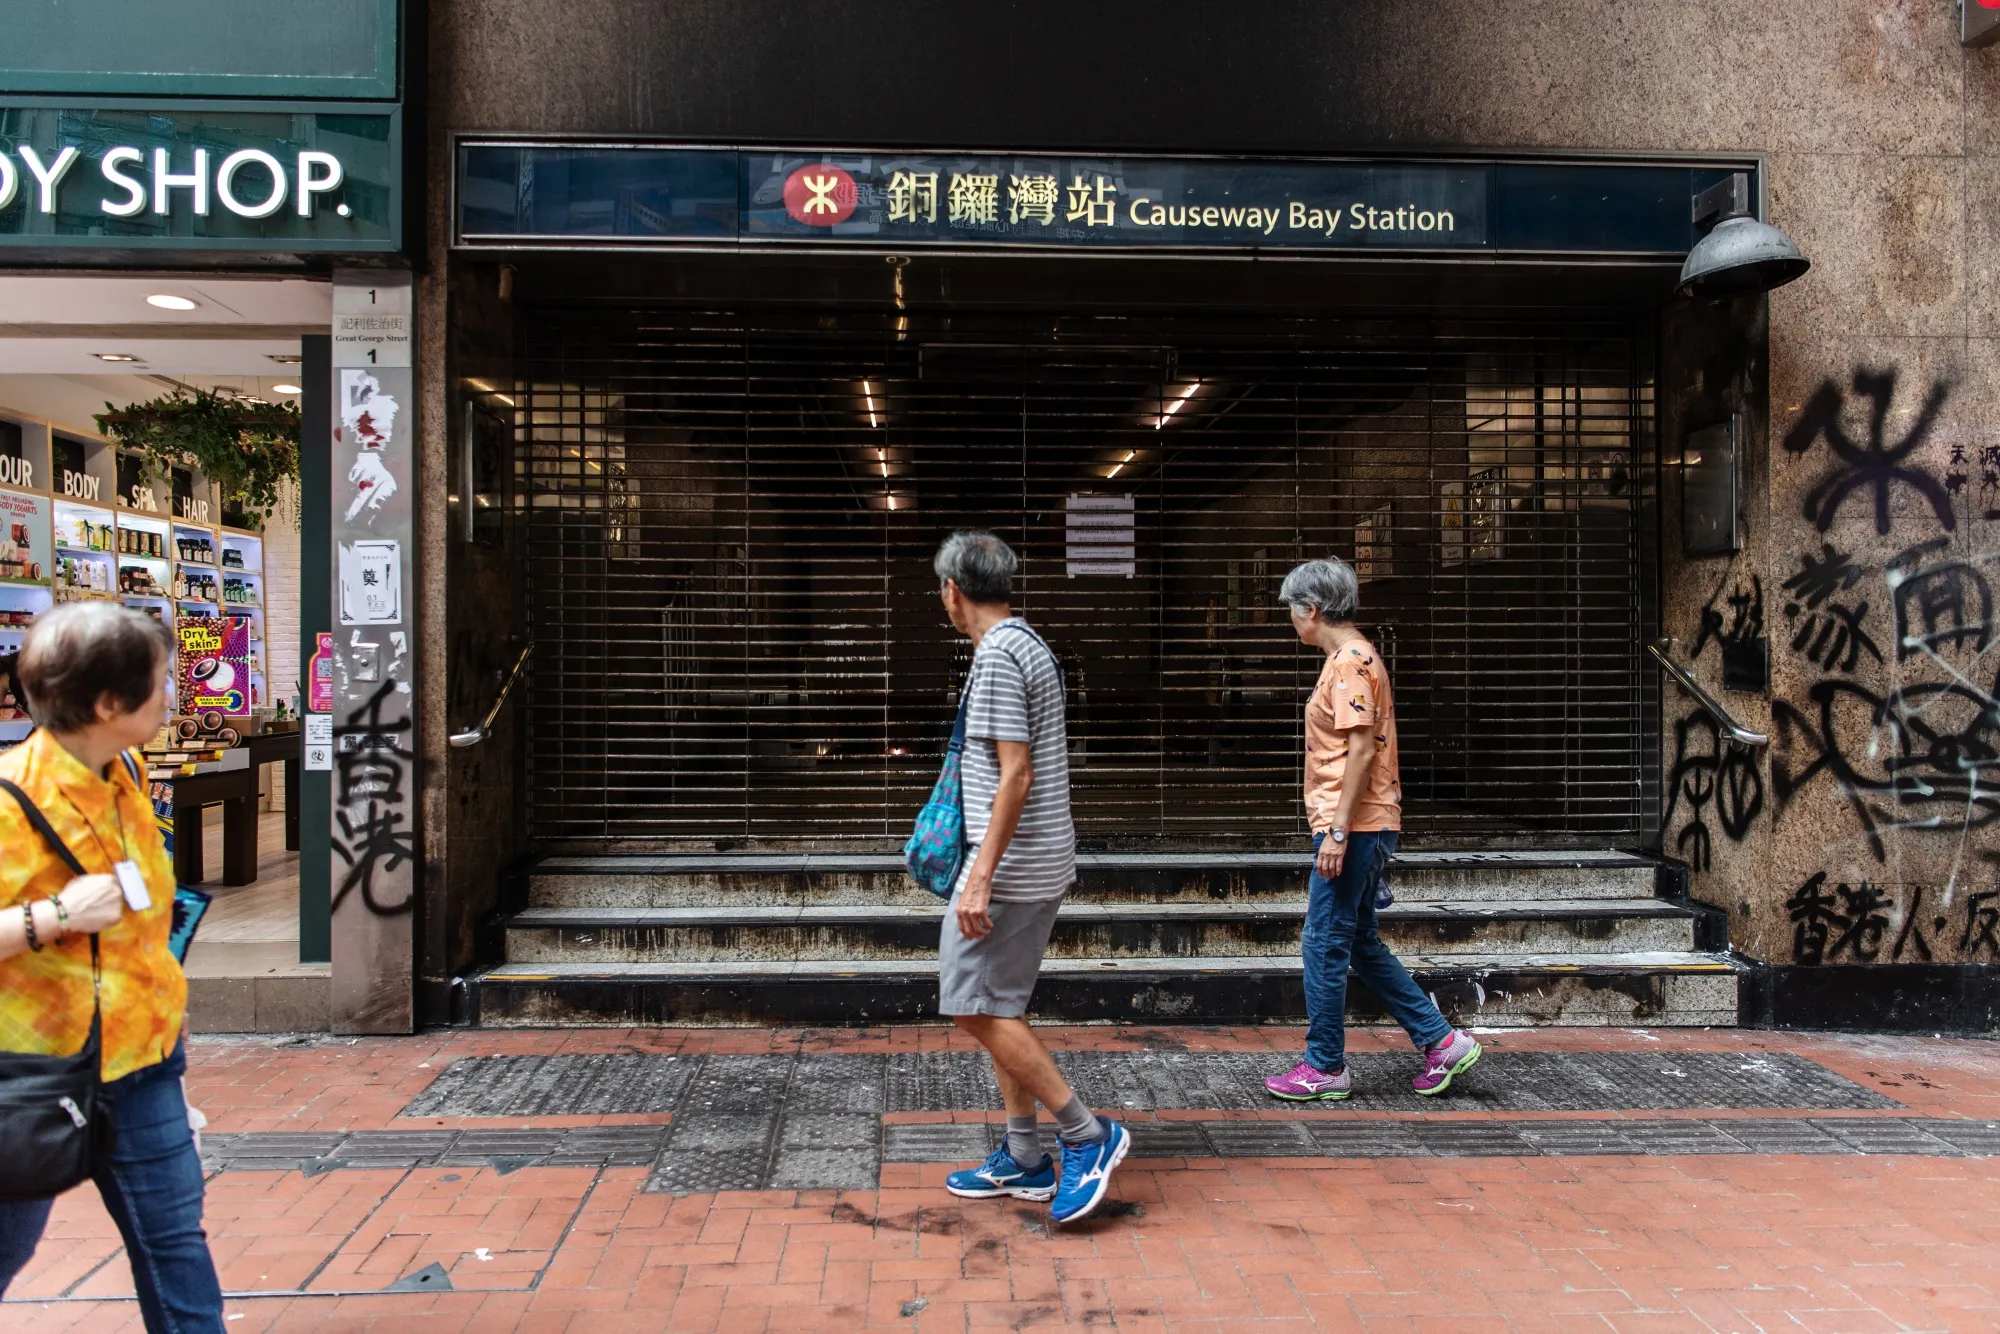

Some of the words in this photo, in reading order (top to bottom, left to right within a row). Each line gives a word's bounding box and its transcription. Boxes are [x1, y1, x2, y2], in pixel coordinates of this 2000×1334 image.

[101, 147, 350, 218] SHOP.
[887, 171, 1118, 227] 銅鑼灣站
[1129, 197, 1281, 236] Causeway
[1289, 202, 1342, 237] Bay
[1349, 203, 1455, 232] Station
[368, 289, 376, 305] 1
[341, 317, 403, 330] 記利佐治街
[358, 335, 385, 343] George
[367, 348, 377, 364] 1
[63, 469, 101, 501] BODY
[183, 495, 209, 523] HAIR
[183, 630, 205, 640] Dry
[189, 638, 219, 649] skin?
